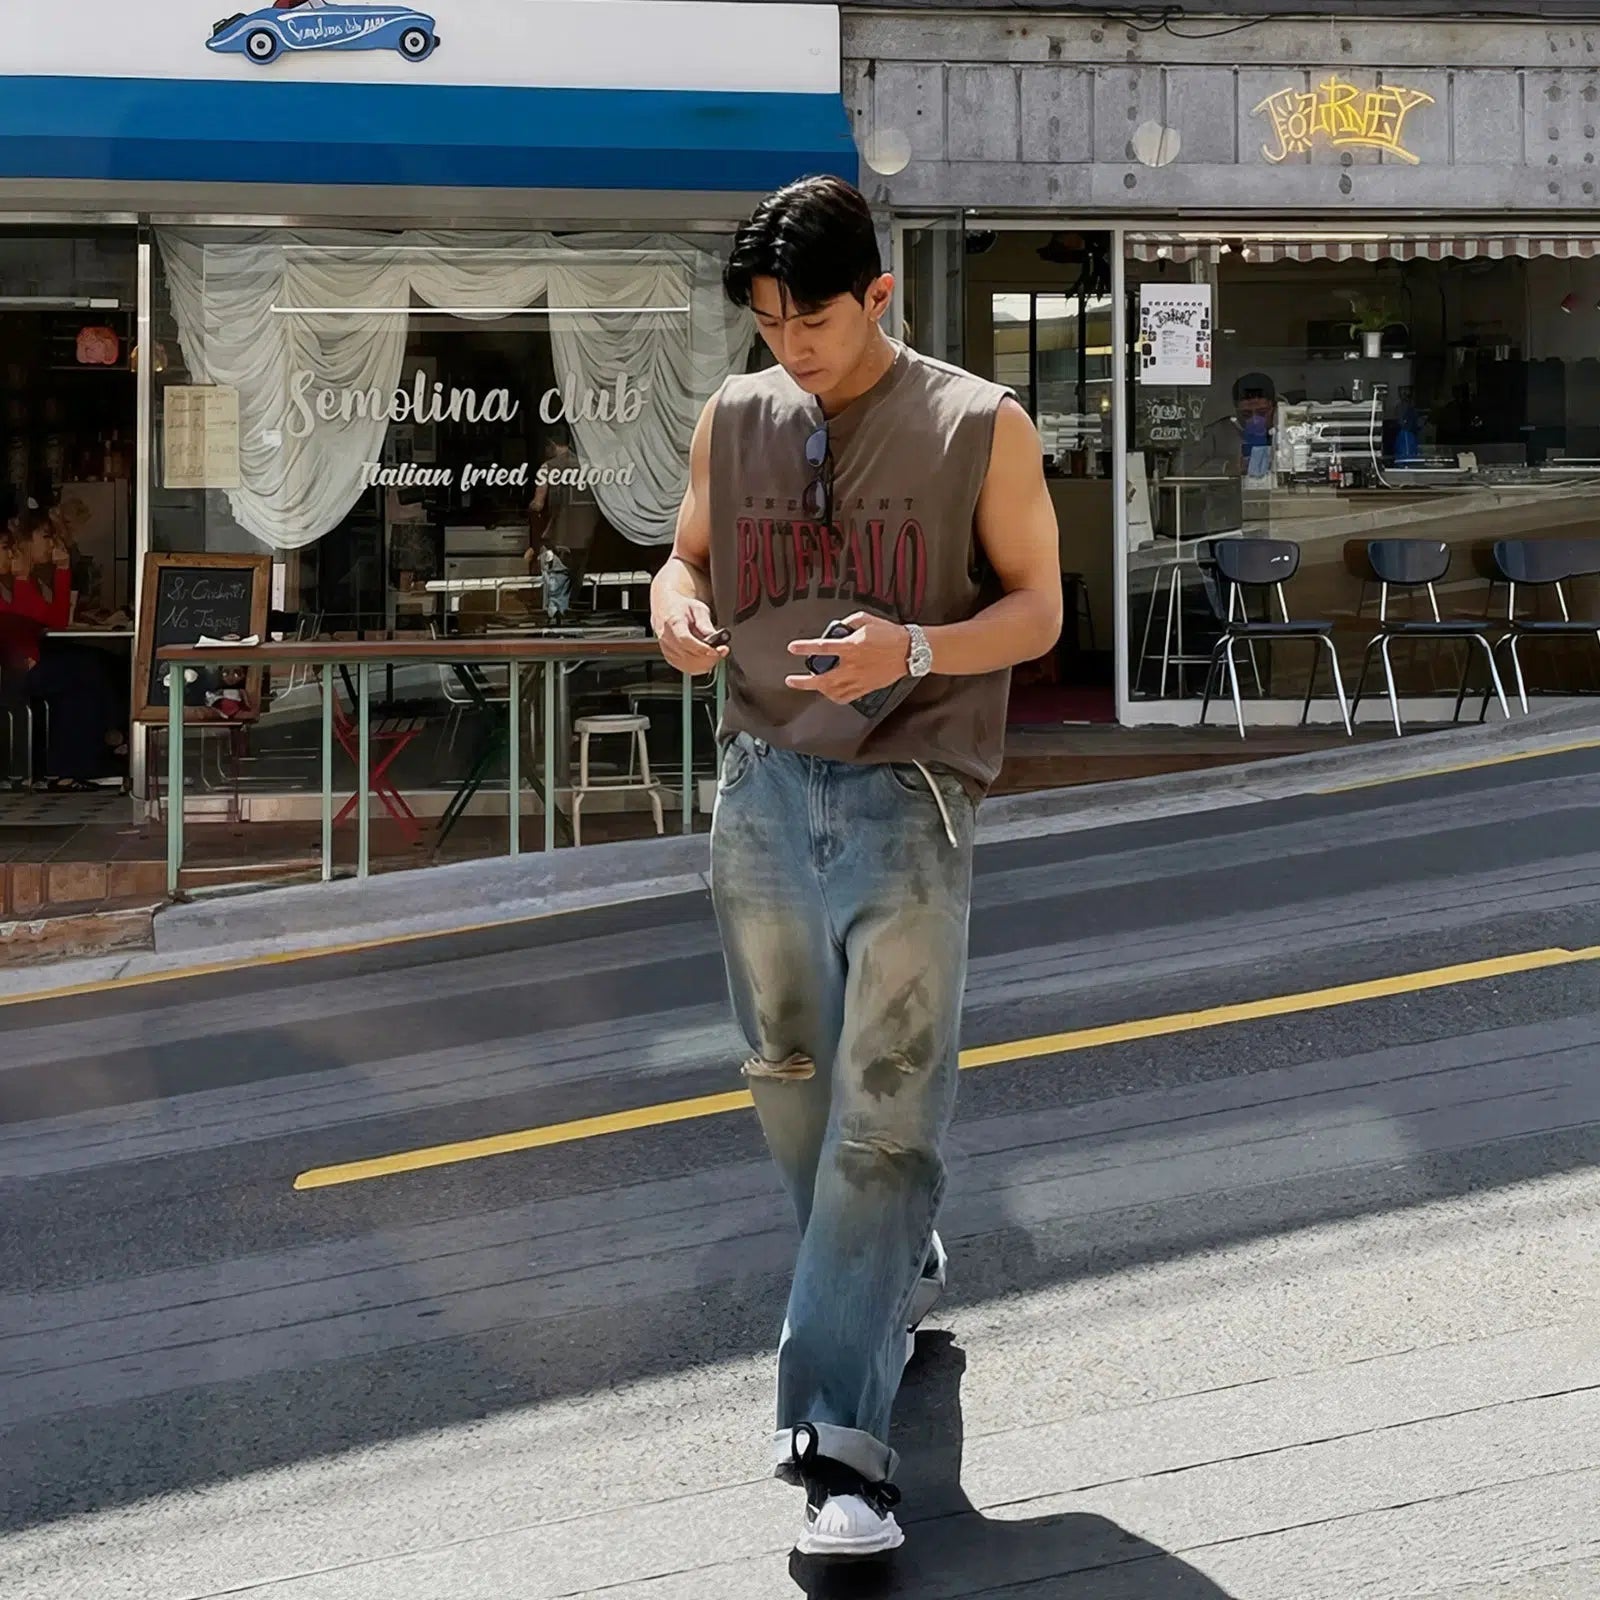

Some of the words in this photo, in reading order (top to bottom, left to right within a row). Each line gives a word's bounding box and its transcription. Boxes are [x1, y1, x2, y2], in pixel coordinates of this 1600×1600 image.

[285, 369, 520, 439] Semolina
[538, 370, 652, 425] club
[358, 460, 454, 488] Italian
[459, 462, 530, 492] fried
[534, 462, 636, 492] seafood
[733, 516, 928, 626] BUFFALO
[162, 605, 189, 628] No
